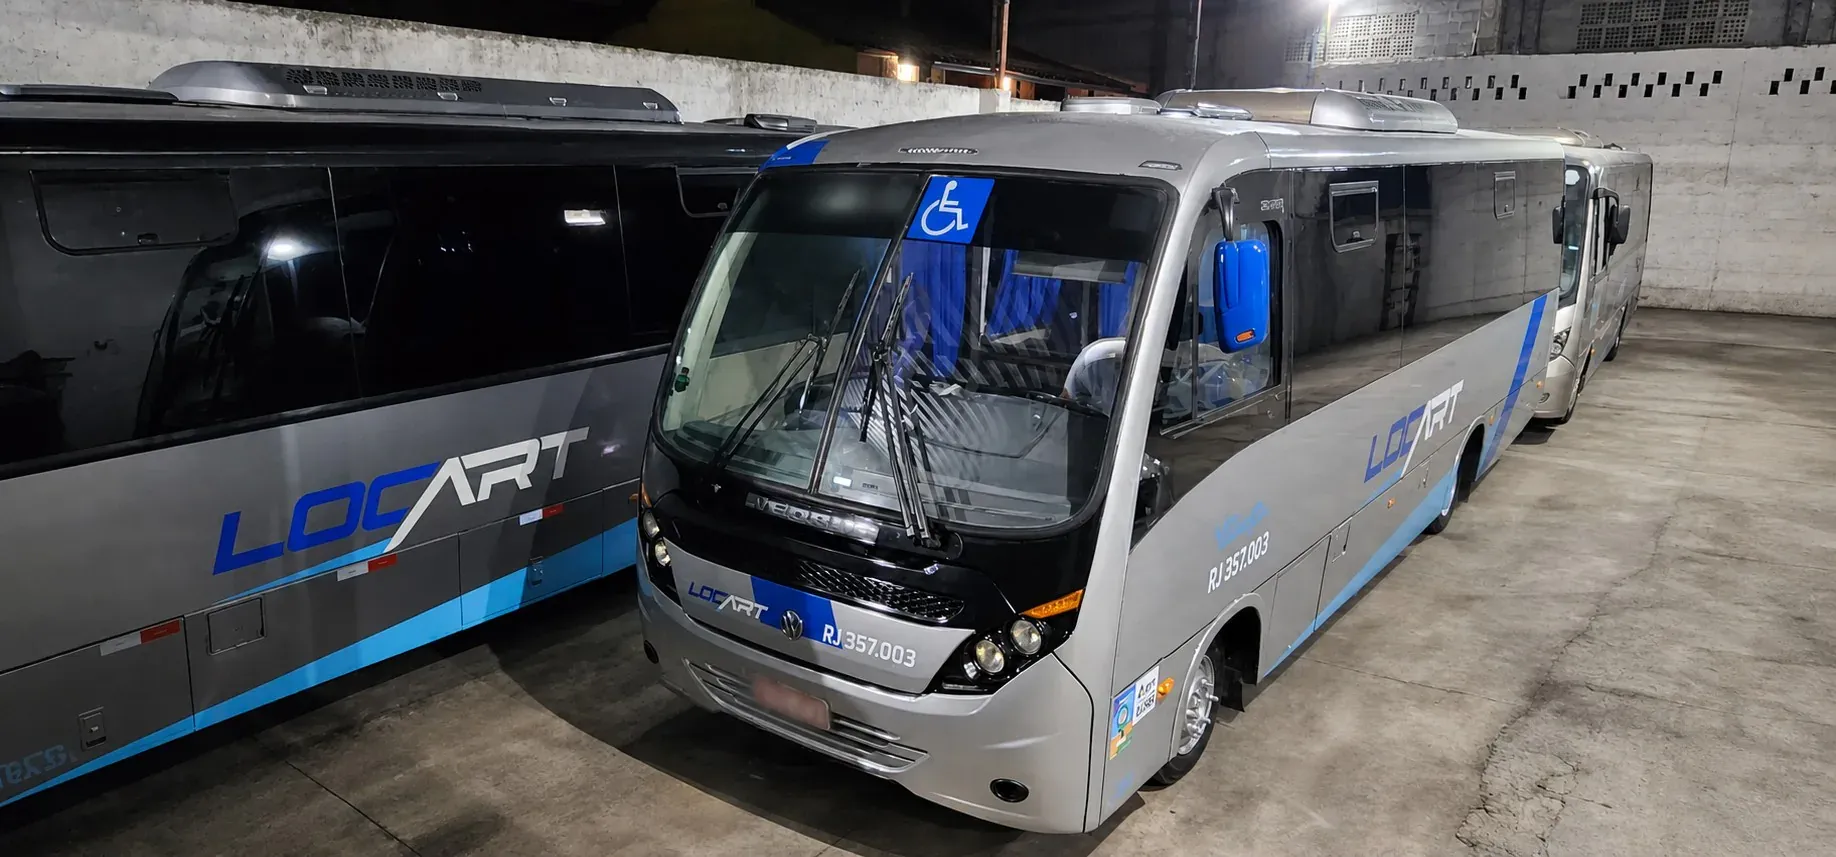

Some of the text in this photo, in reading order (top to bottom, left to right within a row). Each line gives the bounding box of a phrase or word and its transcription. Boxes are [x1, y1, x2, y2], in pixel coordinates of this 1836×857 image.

[1364, 379, 1464, 483] LOCART
[213, 427, 590, 576] LOCART
[1207, 530, 1269, 594] RJ 357.003
[688, 581, 768, 620] LOCART
[822, 624, 916, 668] RJ 357.003
